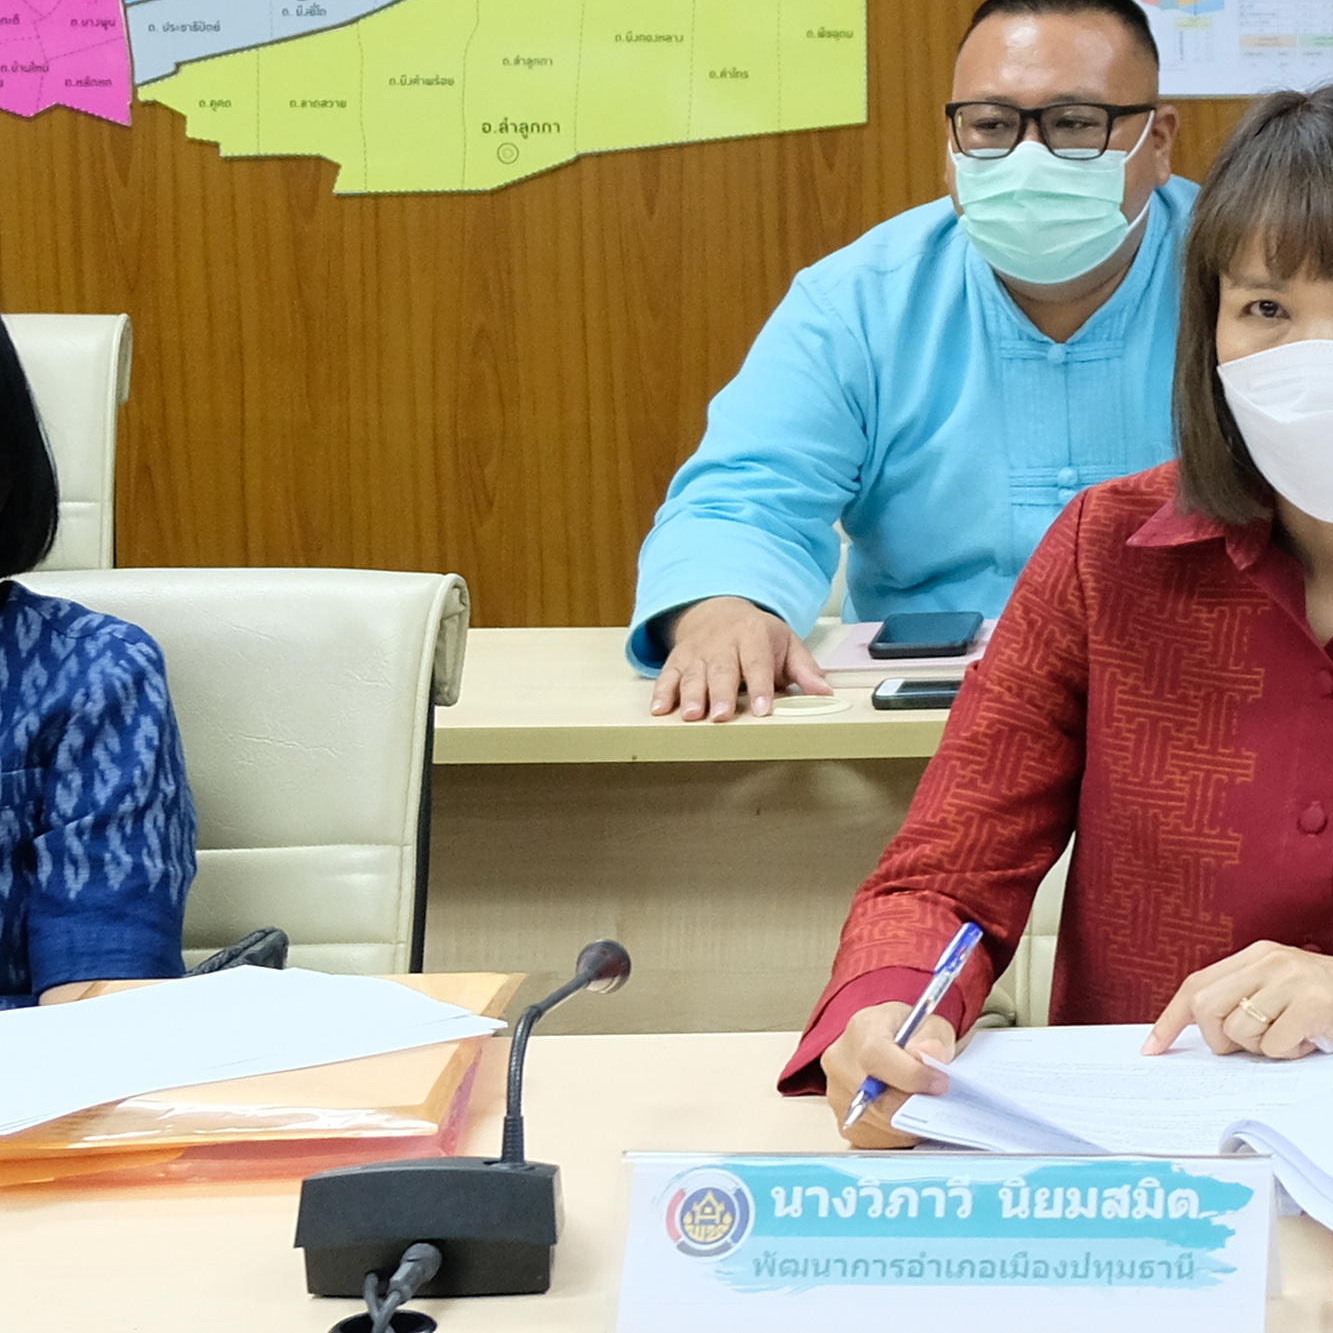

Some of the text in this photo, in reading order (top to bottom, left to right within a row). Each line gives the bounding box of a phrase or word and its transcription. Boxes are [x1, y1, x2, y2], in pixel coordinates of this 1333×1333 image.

[481, 117, 561, 140] อ.ลำลูกกา
[770, 1176, 1200, 1219] นางวิภาวี นิยมสมิต
[752, 1250, 1195, 1286] พัฒนาการอำเภอเมืองปทุมธานี
